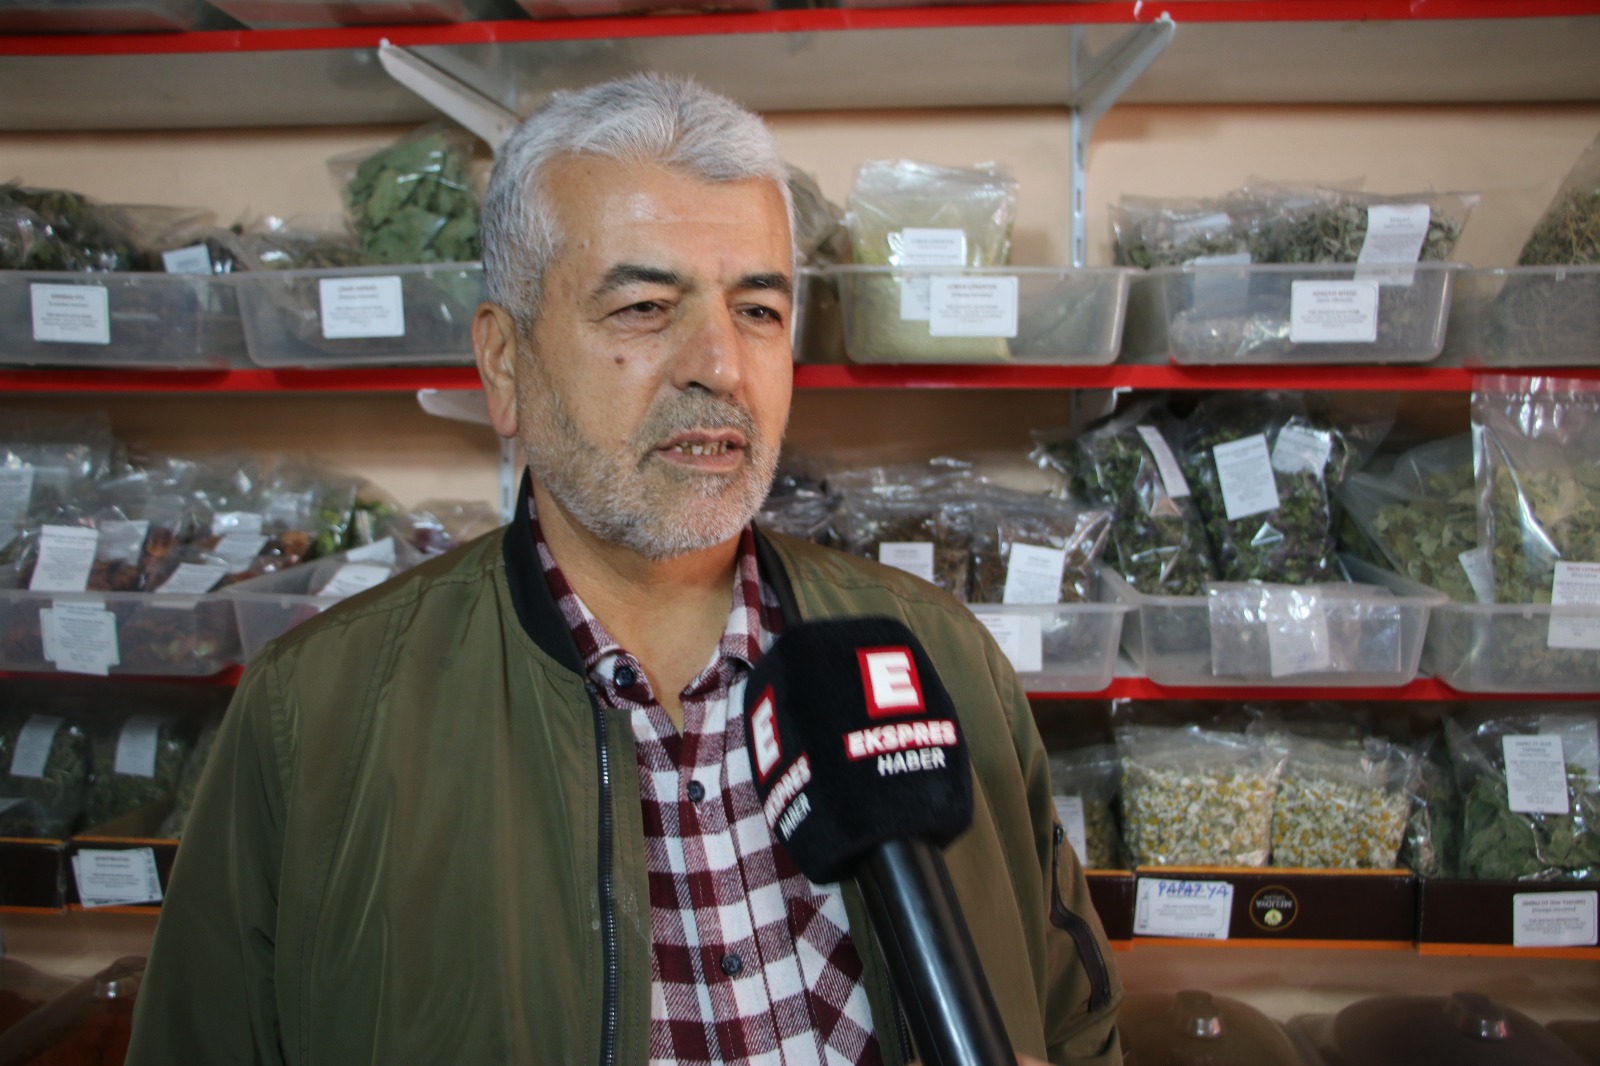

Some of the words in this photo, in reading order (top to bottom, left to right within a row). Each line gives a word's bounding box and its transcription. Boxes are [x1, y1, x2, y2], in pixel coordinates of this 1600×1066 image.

[866, 651, 919, 709] E
[752, 697, 781, 777] E
[848, 721, 957, 758] EKSPRES
[877, 747, 946, 777] HABER
[779, 792, 812, 841] HABER
